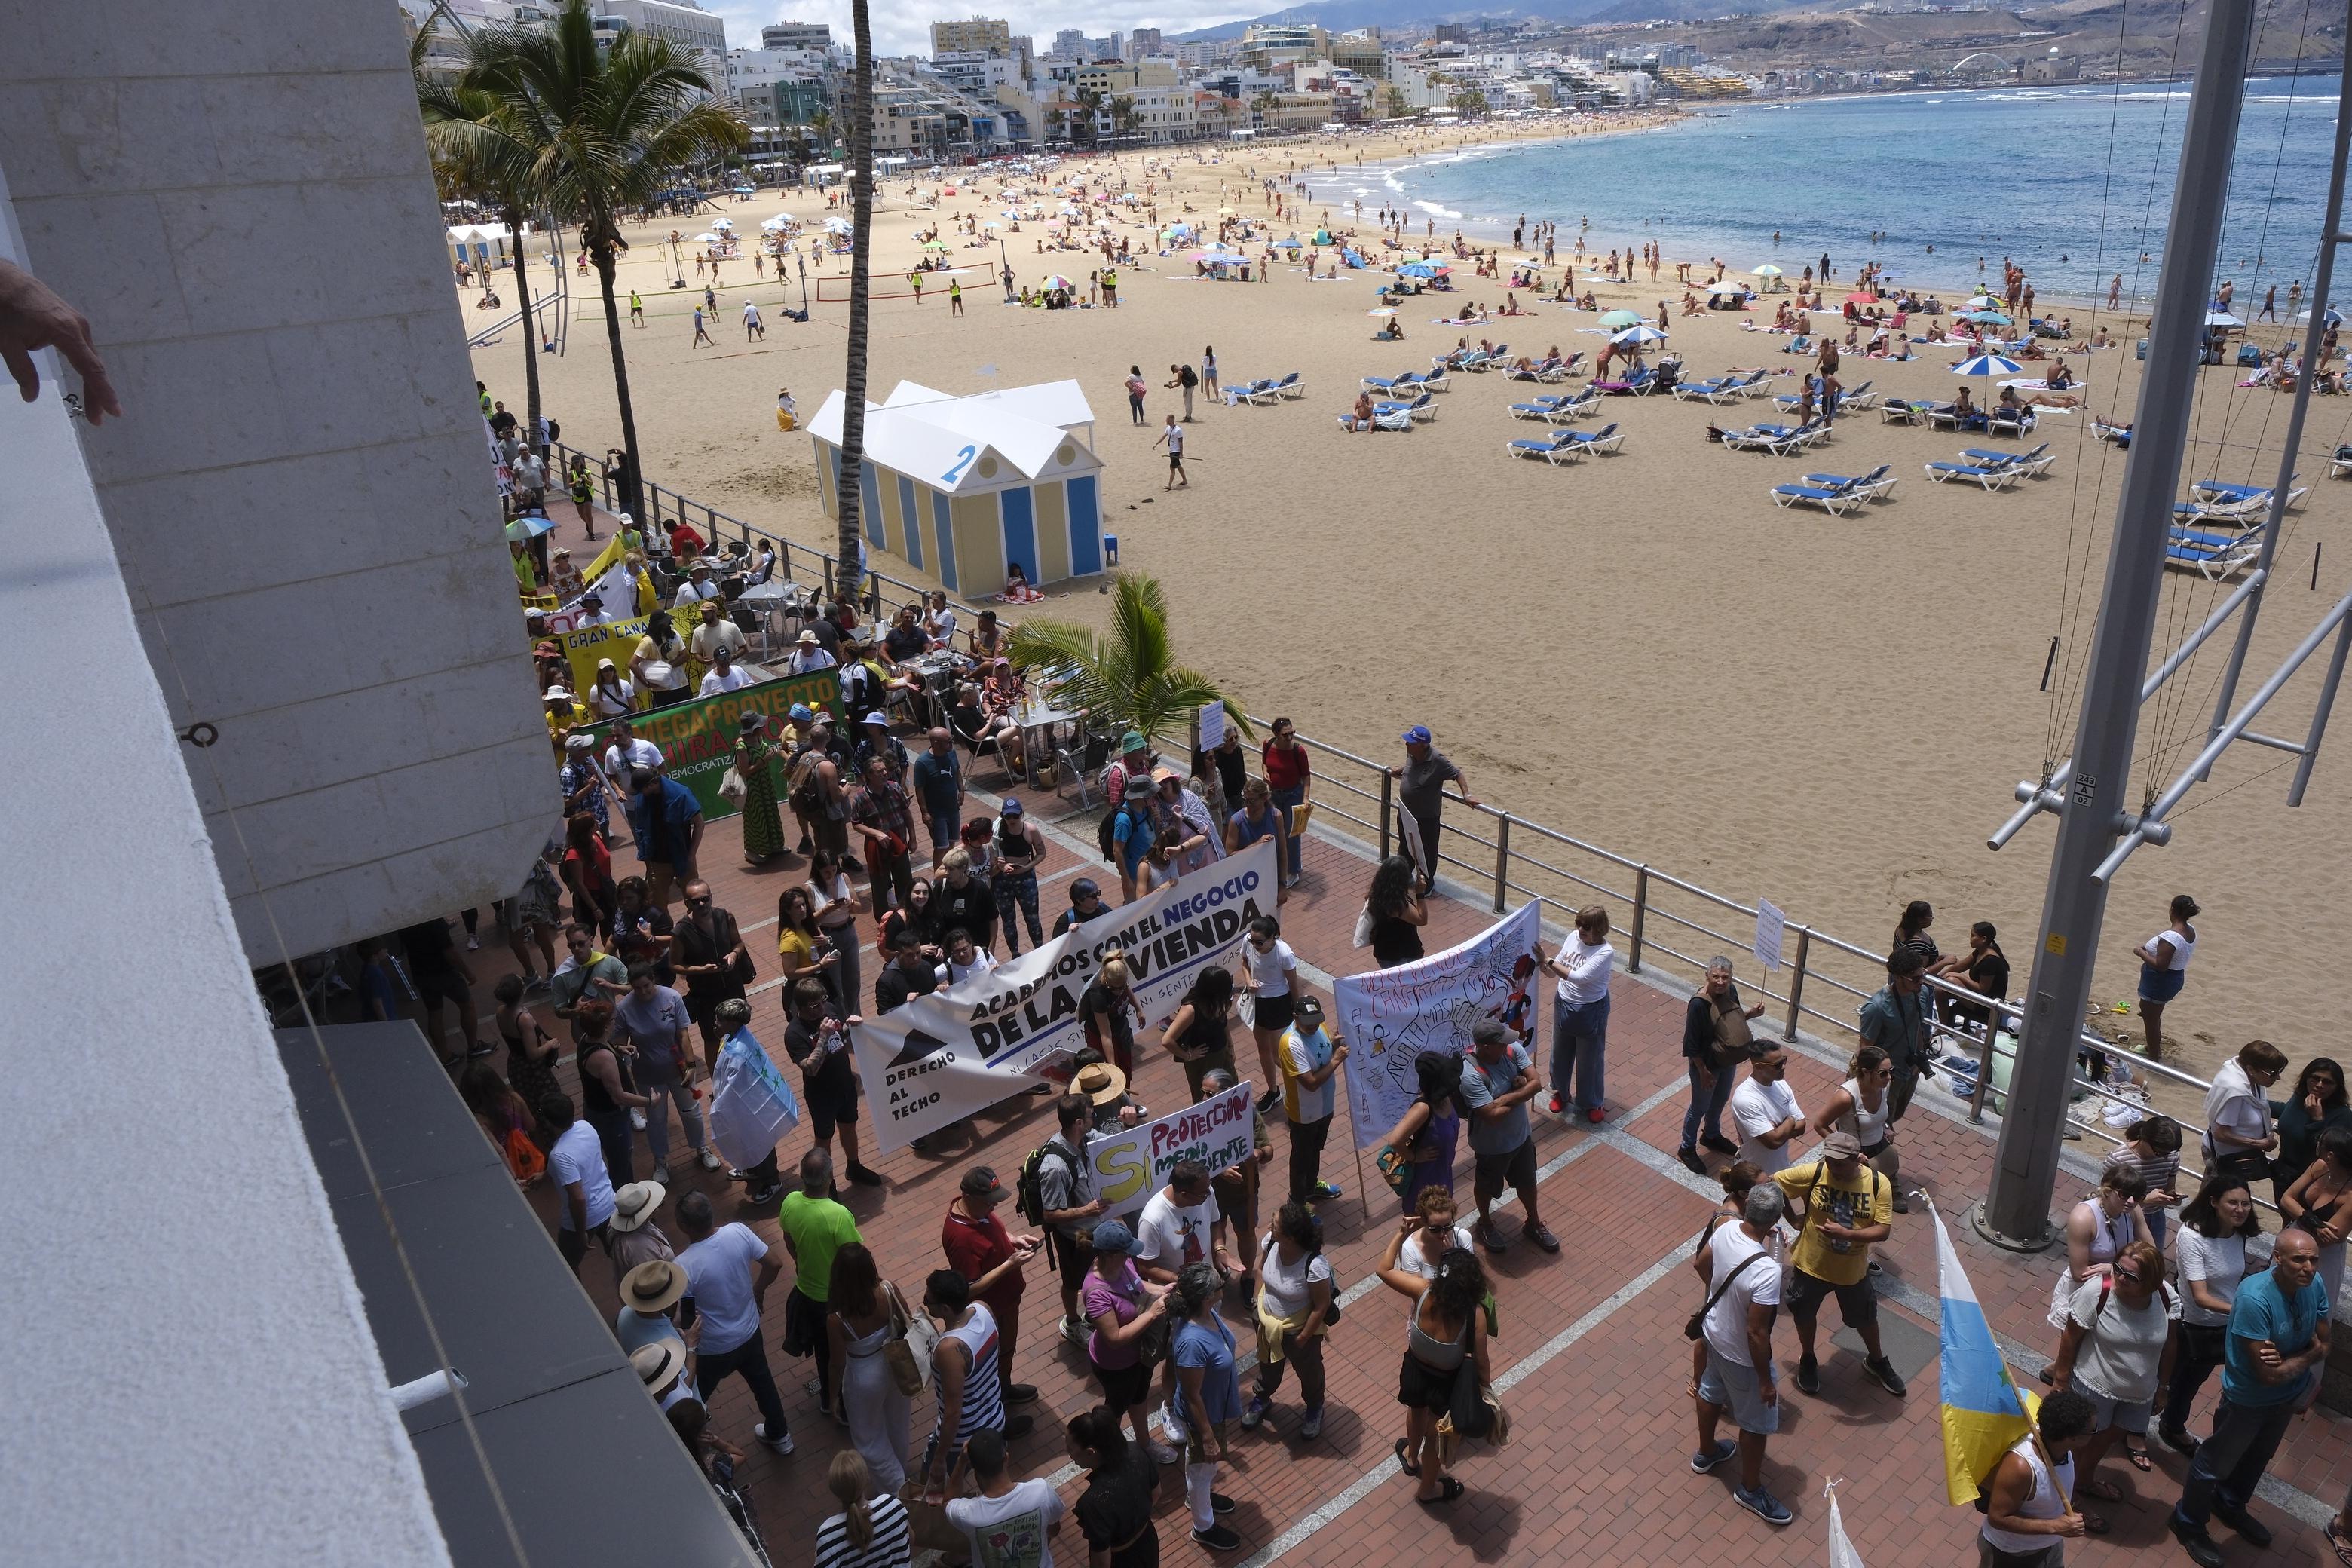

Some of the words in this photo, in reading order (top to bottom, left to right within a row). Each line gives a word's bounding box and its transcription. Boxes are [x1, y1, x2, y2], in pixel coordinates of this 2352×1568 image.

[941, 445, 976, 483] 2
[568, 629, 608, 649] GRAN
[614, 623, 648, 639] CANA
[2078, 774, 2094, 785] 243
[2078, 796, 2088, 805] 02
[1093, 926, 1138, 963] CON
[1138, 914, 1162, 941] EL
[1162, 871, 1260, 928] NEGOCIO
[1140, 996, 1153, 1008] NI
[1158, 973, 1196, 999] GENTE
[969, 1009, 1028, 1060] DE
[1024, 984, 1077, 1031] LA
[885, 1051, 956, 1087] DERECHO
[890, 1085, 909, 1104] AL
[891, 1091, 942, 1122] TECHO
[1096, 1142, 1153, 1205] SÍ
[1818, 1185, 1870, 1211] SKATE
